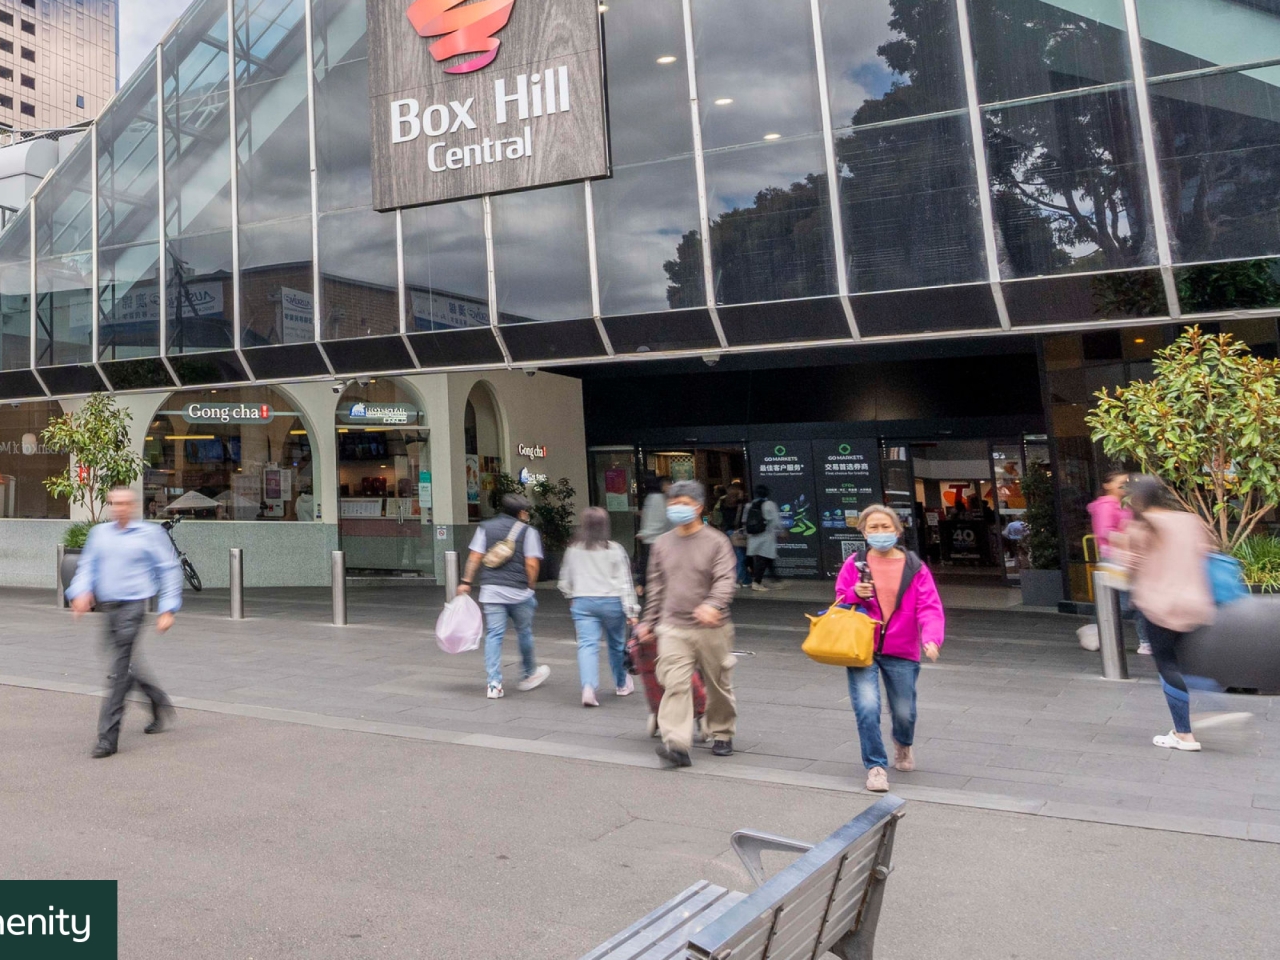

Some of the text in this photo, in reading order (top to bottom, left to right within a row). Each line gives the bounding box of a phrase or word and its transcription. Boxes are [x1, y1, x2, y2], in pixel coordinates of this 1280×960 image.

[390, 65, 570, 144] Box Hill
[427, 126, 532, 172] Central
[188, 403, 230, 423] Gong
[232, 404, 260, 419] cha
[518, 443, 544, 460] Gong cha
